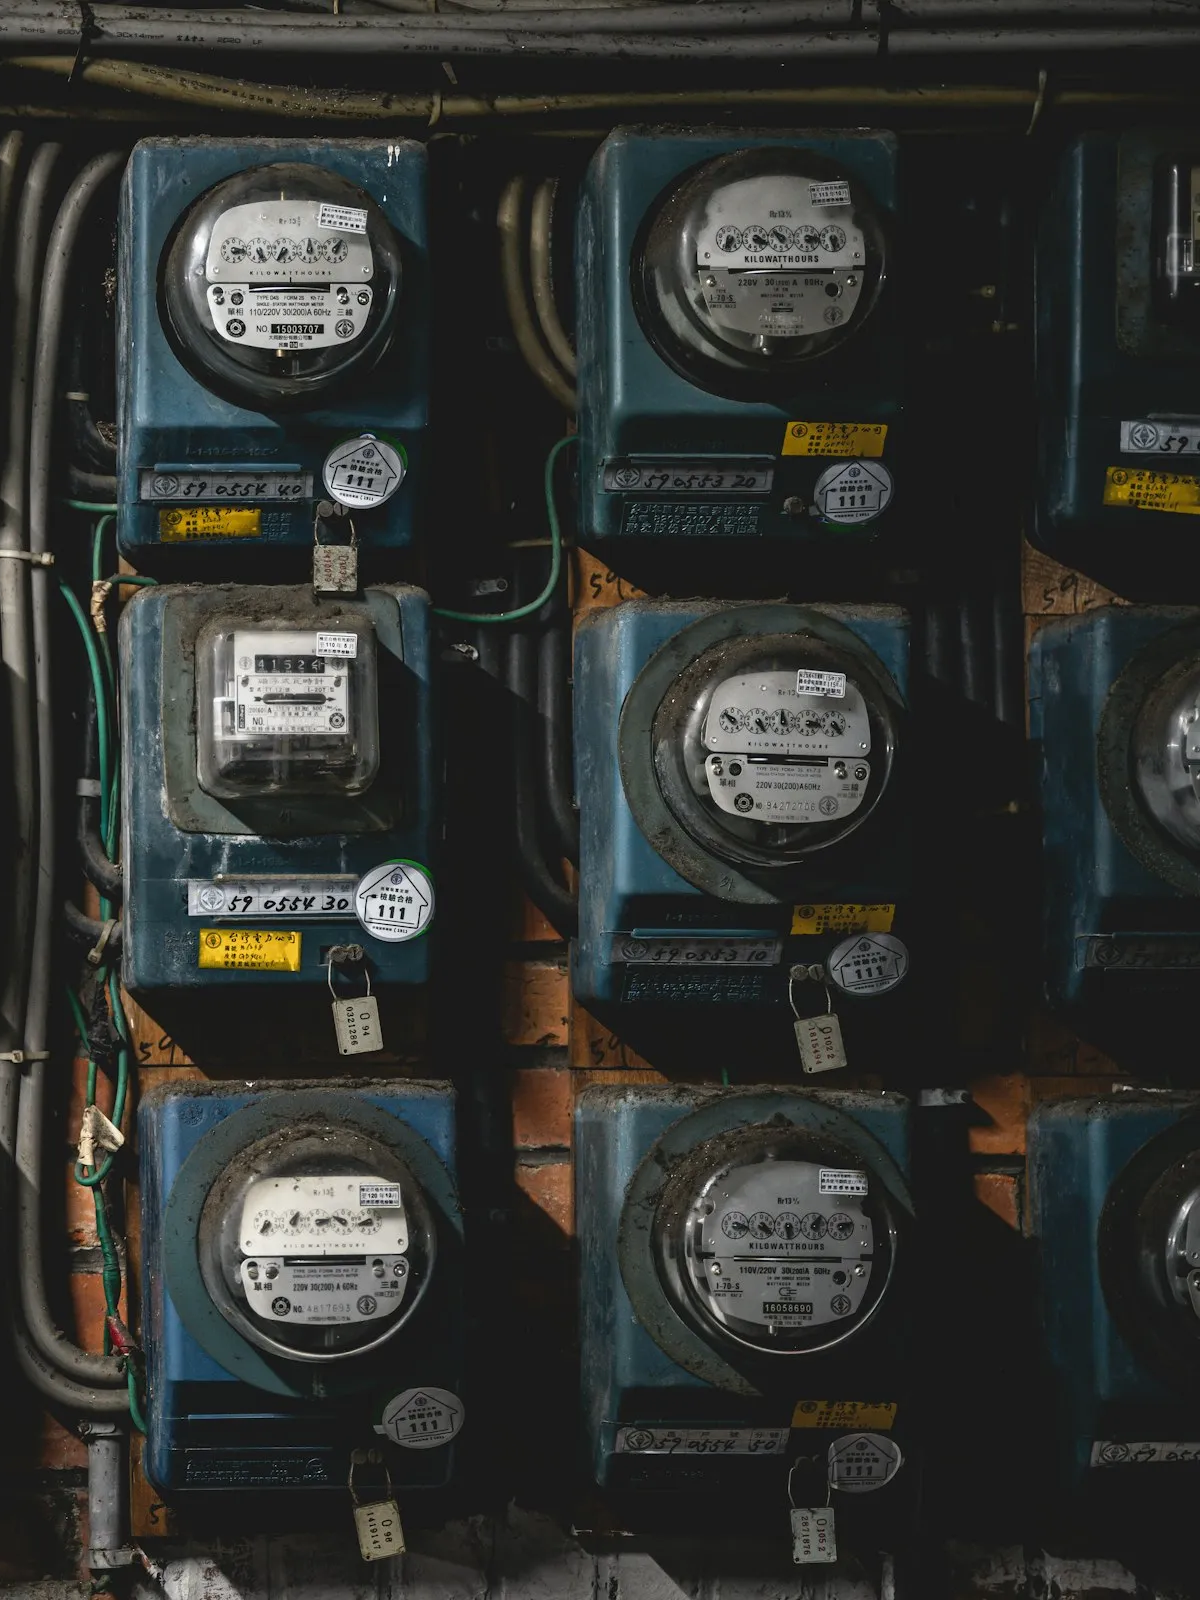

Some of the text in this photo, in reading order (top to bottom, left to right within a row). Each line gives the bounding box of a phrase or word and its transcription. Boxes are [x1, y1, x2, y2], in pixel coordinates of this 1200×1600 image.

[744, 255, 819, 263] KILOWATTHOURS
[248, 308, 281, 317] 110/220V
[313, 308, 331, 317] 60Hz
[276, 325, 319, 334] 15003707
[1160, 435, 1188, 453] 59
[350, 463, 383, 476] 檢驗合格
[346, 473, 375, 488] 111
[644, 474, 757, 489] 59 0553 20
[183, 481, 207, 497] 59
[838, 484, 873, 492] 檢驗合格
[838, 495, 867, 507] 111
[228, 895, 349, 912] 59 0554 30
[380, 892, 413, 905] 檢驗合格
[378, 904, 406, 920] 111
[652, 950, 767, 962] 59 0553 10
[855, 966, 883, 980] 111
[346, 1006, 358, 1046] 0321286
[808, 1027, 822, 1065] 1815494
[749, 1242, 825, 1251] KILOWATTHOURS
[739, 1266, 777, 1274] 110V/220V
[764, 1302, 812, 1313] 16058690
[409, 1420, 439, 1433] 111
[654, 1437, 681, 1453] 59
[748, 1439, 777, 1452] 50
[367, 1512, 381, 1549] 1419147
[801, 1516, 811, 1555] 2871876
